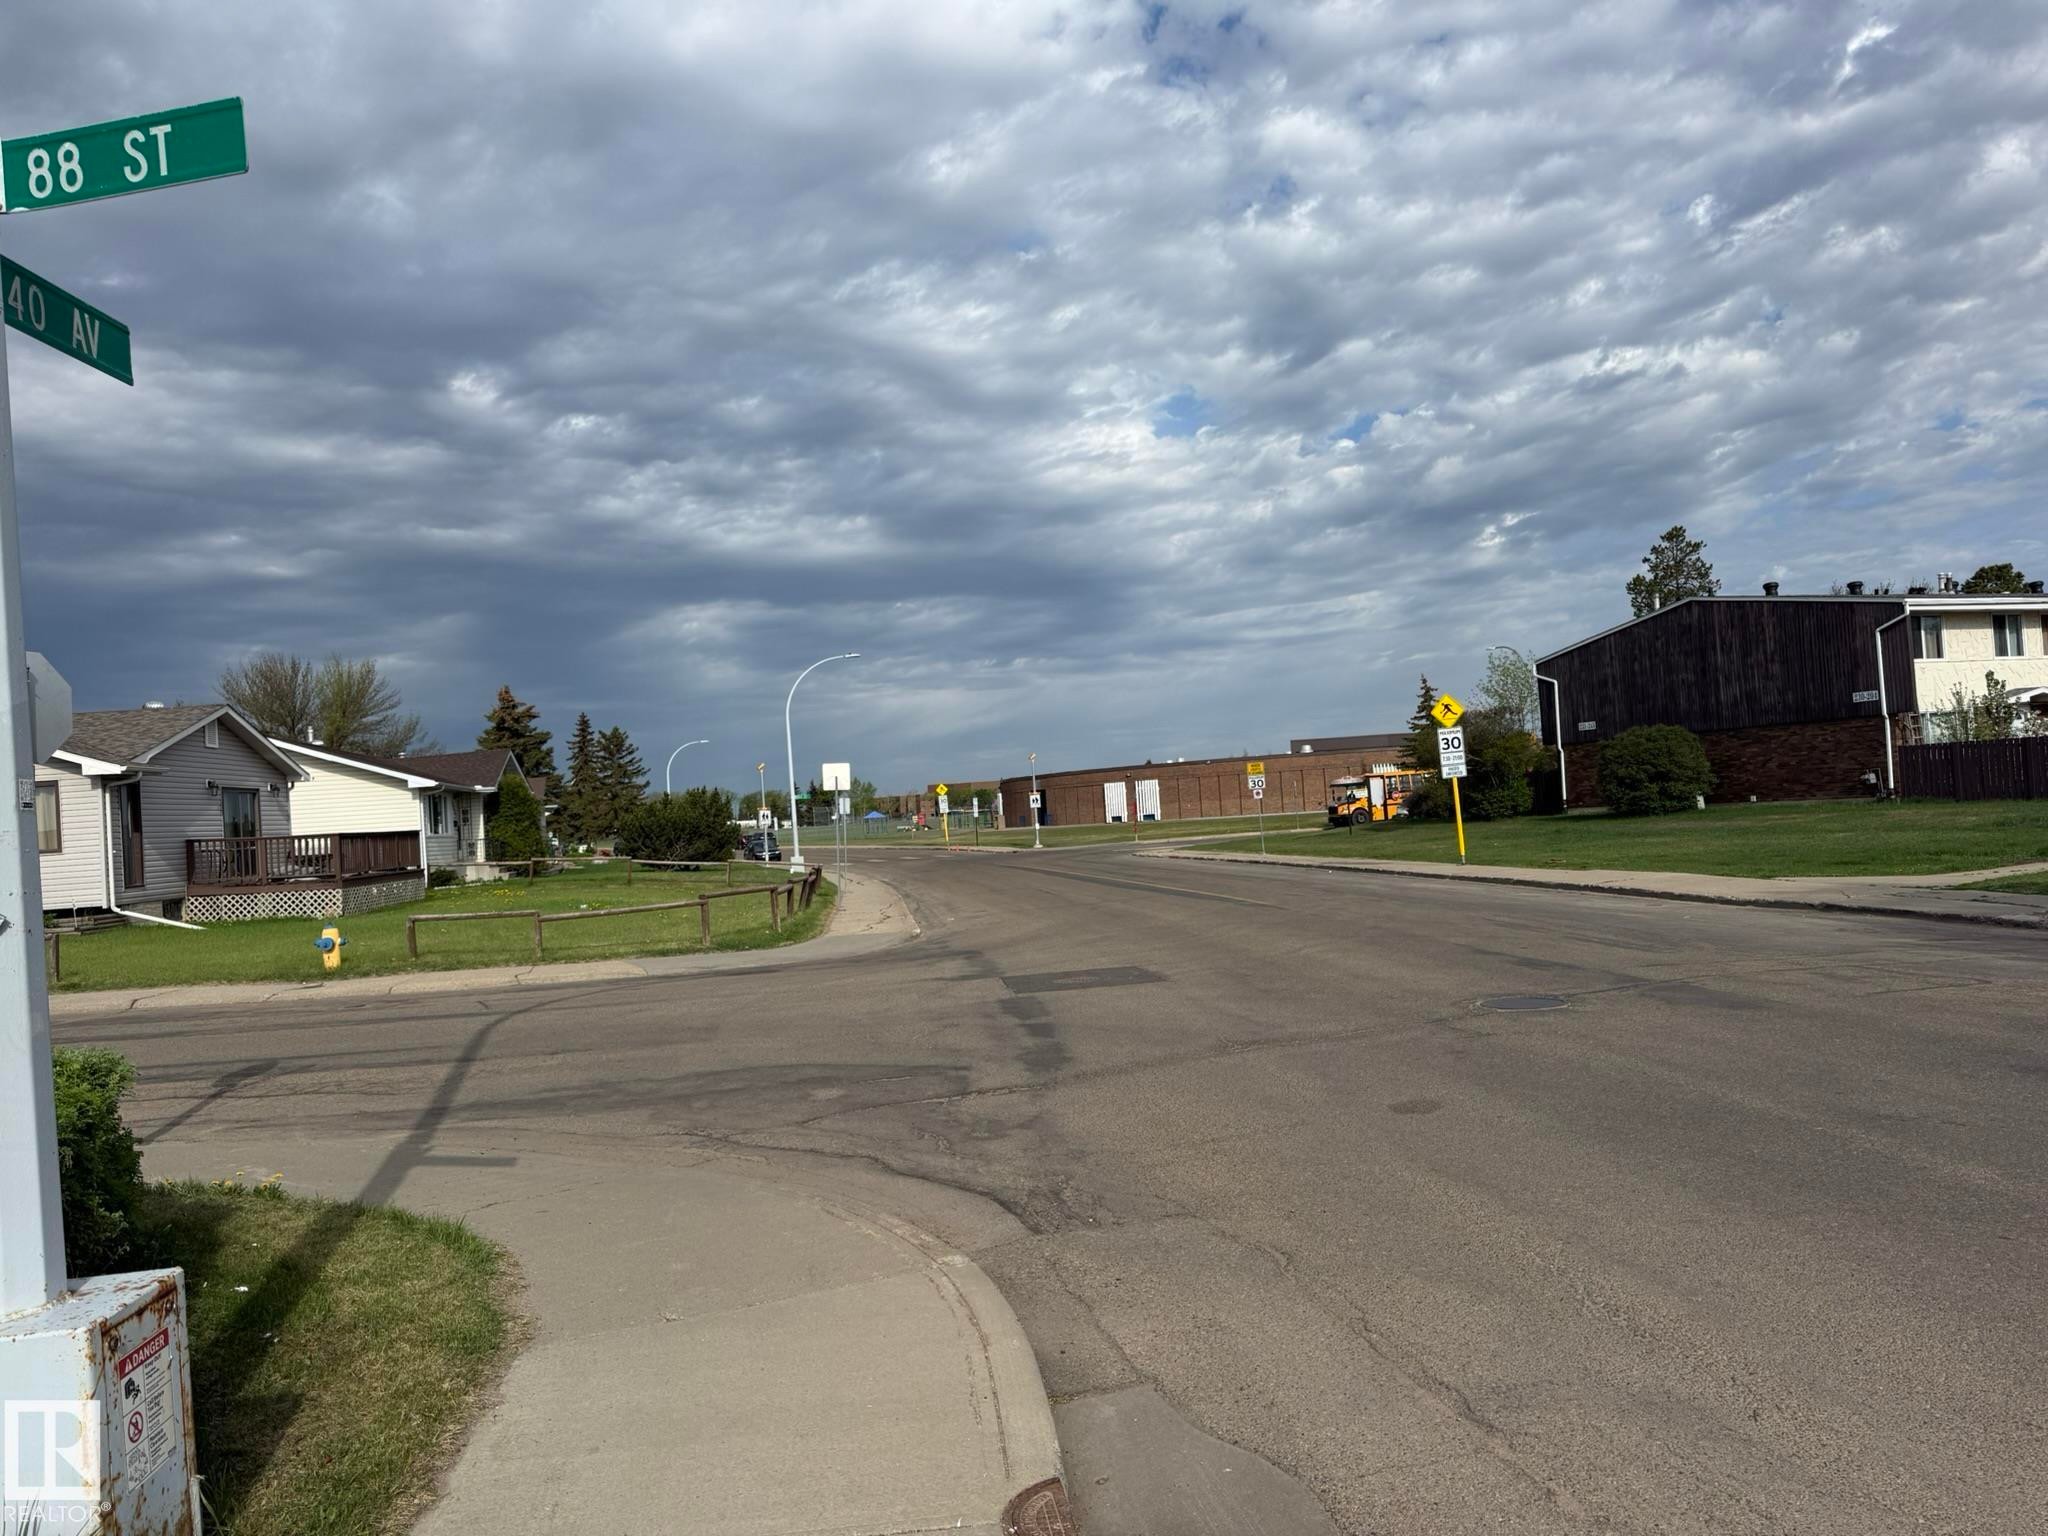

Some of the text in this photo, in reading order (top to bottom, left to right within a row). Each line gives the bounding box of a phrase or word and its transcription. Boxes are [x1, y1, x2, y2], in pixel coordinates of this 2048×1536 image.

[27, 124, 172, 198] 88 ST
[8, 275, 100, 359] 40 AV
[1441, 736, 1461, 750] 30
[1250, 779, 1264, 788] 30
[132, 1333, 165, 1367] DANGER
